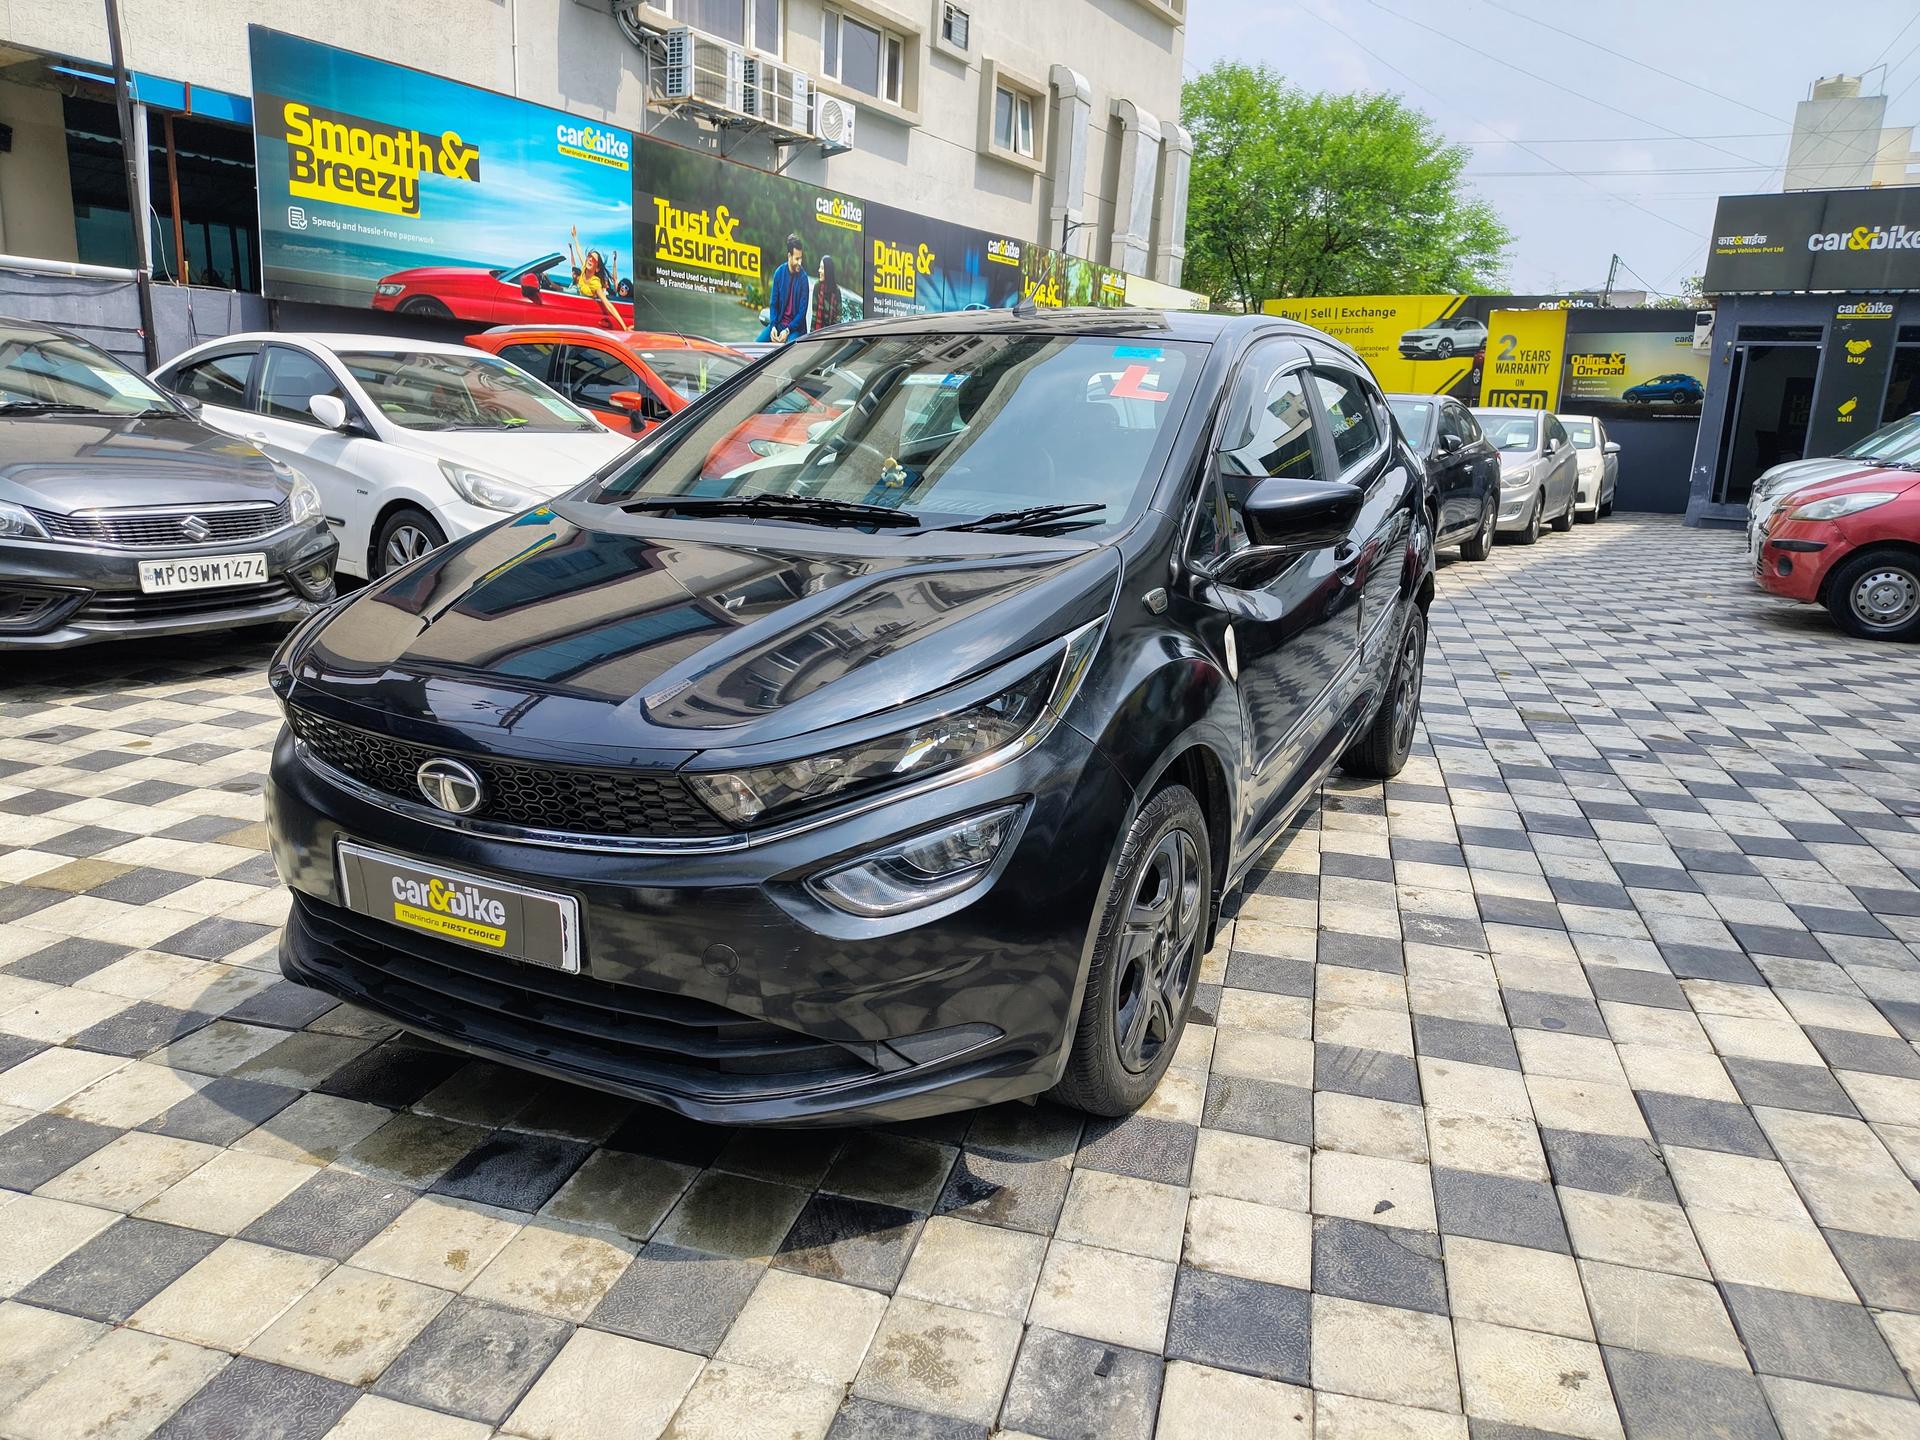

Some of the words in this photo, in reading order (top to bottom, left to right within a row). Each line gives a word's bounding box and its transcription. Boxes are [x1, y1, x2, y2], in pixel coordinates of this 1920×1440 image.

[284, 103, 433, 173] Smooth
[438, 131, 479, 181] &
[557, 125, 628, 159] car&bike
[588, 154, 604, 163] FIRST
[604, 158, 623, 167] CHOICE
[290, 147, 419, 214] Breezy
[653, 197, 709, 236] Trust
[714, 205, 739, 242] &
[816, 197, 862, 222] car&bike
[312, 216, 341, 231] Speedy
[342, 219, 356, 231] and
[358, 223, 397, 239] hassle-free
[398, 231, 434, 245] paperwork
[656, 227, 759, 272] Assurance
[874, 240, 914, 268] Drive
[917, 243, 935, 275] &
[988, 240, 1020, 259] car&bike
[656, 267, 670, 276] Most
[671, 269, 685, 280] loved
[686, 272, 699, 282] Used
[700, 275, 708, 283] Car
[709, 276, 723, 286] brand
[730, 280, 742, 289] India
[660, 278, 668, 288] By
[668, 279, 694, 291] Franchise
[709, 286, 716, 294] ET
[874, 265, 913, 293] Smile
[1282, 310, 1301, 320] Buy
[1311, 308, 1331, 318] Sell
[1341, 307, 1397, 319] Exchange
[1838, 302, 1893, 314] car&bike
[1345, 325, 1374, 334] brands
[1497, 335, 1517, 361] 2
[1520, 350, 1551, 361] YEARS
[1571, 354, 1607, 365] Online
[1609, 352, 1626, 365] &
[1847, 355, 1865, 365] buy
[1495, 363, 1549, 375] WARRANTY
[1577, 365, 1625, 375] On-road
[1837, 415, 1852, 423] sell
[153, 560, 264, 586] MP09WM1474
[392, 876, 506, 925] car&bike
[402, 909, 440, 927] Mahindra
[442, 921, 466, 934] FIRST
[468, 927, 501, 942] CHOICE
